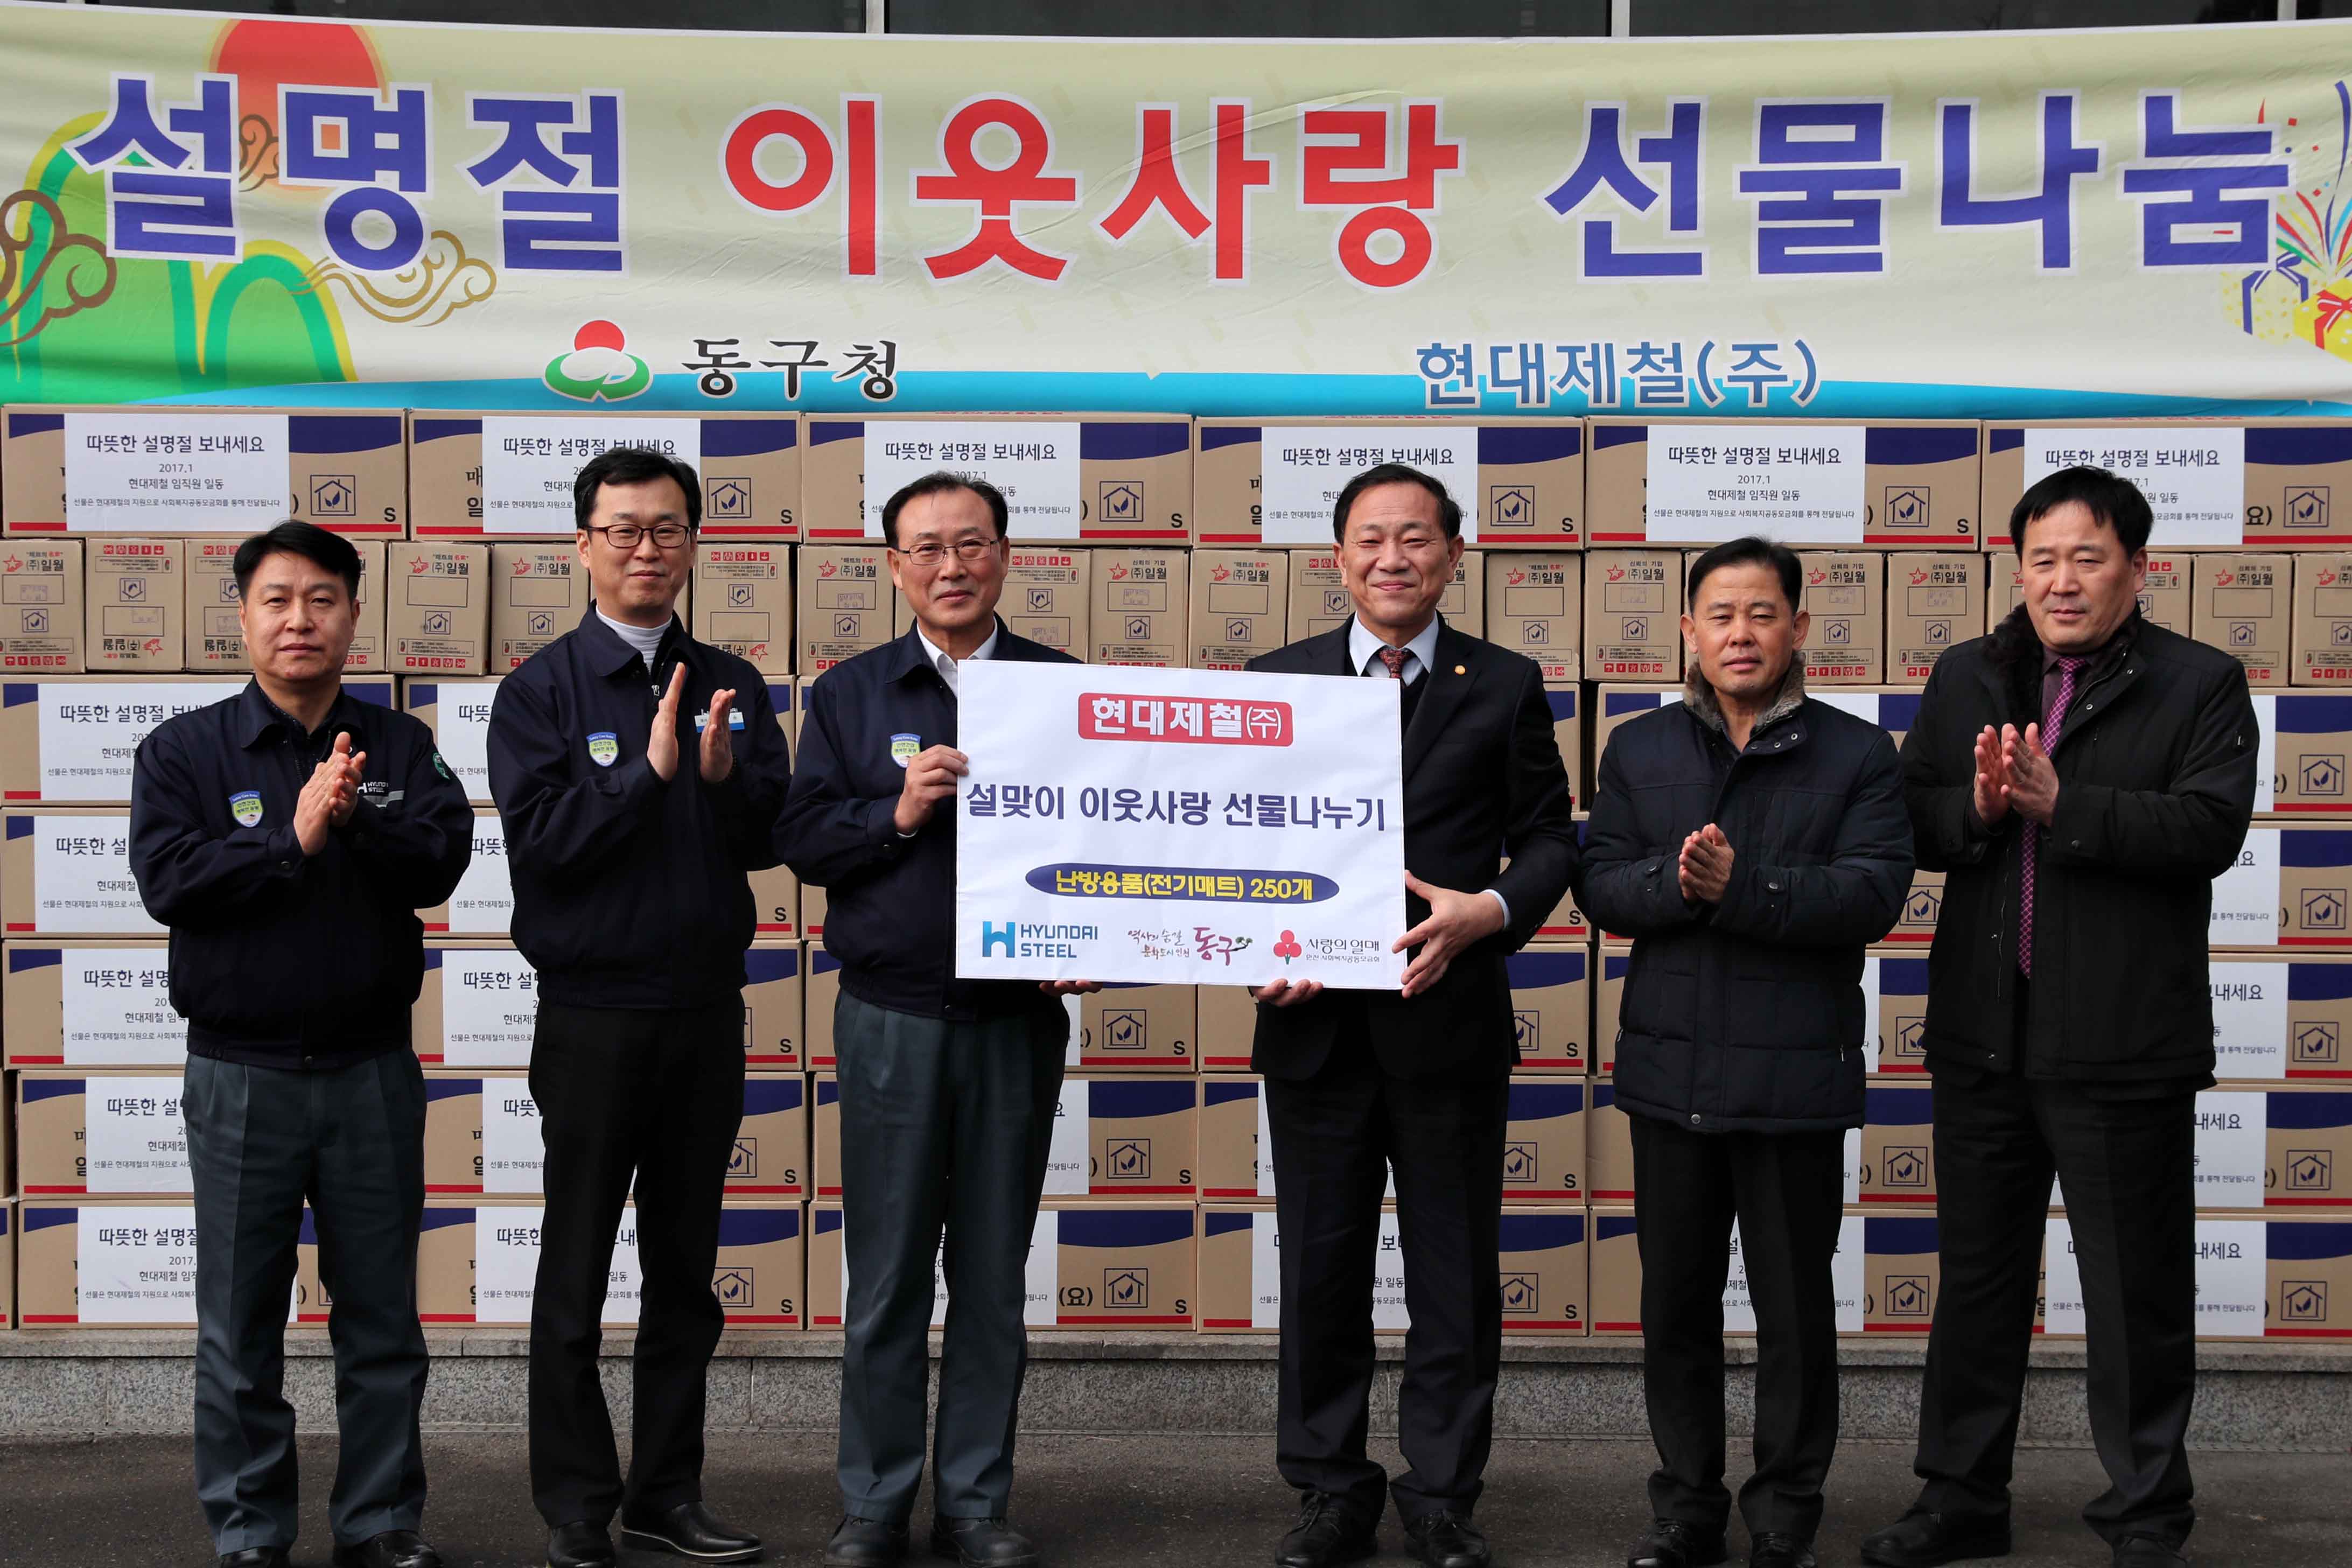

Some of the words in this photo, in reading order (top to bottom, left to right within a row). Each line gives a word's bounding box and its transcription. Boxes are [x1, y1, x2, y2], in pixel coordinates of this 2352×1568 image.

[73, 76, 623, 273] 설명절
[725, 99, 1459, 288] 이웃사랑
[1543, 95, 2290, 277] 선물나눔
[683, 339, 898, 400] 동구청
[1417, 340, 1818, 405] 현대제철(주)
[87, 435, 137, 452] 따뜻한
[143, 436, 191, 453] 설명절
[199, 436, 264, 453] 보내세요
[504, 438, 552, 456] 따뜻한
[558, 438, 606, 456] 설명절
[886, 443, 933, 460] 따뜻한
[939, 443, 985, 461] 설명절
[993, 444, 1056, 460] 보내세요
[1284, 448, 1331, 465] 따뜻한
[1336, 448, 1383, 466] 설명절
[1391, 447, 1454, 466] 보내세요
[1669, 447, 1717, 464] 따뜻한
[1723, 447, 1769, 465] 설명절
[1777, 448, 1841, 465] 보내세요
[2046, 450, 2095, 467] 따뜻한
[2101, 450, 2148, 468] 설명절
[2155, 450, 2220, 467] 보내세요
[159, 464, 192, 473] 2017.1
[129, 478, 168, 489] 현대제철
[172, 479, 201, 489] 임직원
[205, 479, 224, 489] 일동
[1738, 475, 1769, 484] 2017.1
[998, 487, 1016, 498] 일동
[1708, 490, 1745, 500] 현대제철
[1749, 490, 1777, 501] 임직원
[1782, 490, 1800, 501] 일동
[2160, 493, 2179, 503] 일동
[384, 507, 396, 522] S
[781, 509, 792, 524] S
[1171, 514, 1182, 528] S
[1562, 517, 1573, 532] S
[1957, 519, 1969, 533] S
[61, 705, 109, 723] 따뜻한
[116, 705, 164, 724] 설명절
[1092, 698, 1282, 739] 현대제철(주)
[967, 784, 1064, 820] 설맞이
[1080, 787, 1211, 825] 이웃사랑
[1223, 793, 1384, 831] 선물나누기
[57, 838, 106, 855] 따뜻한
[97, 879, 137, 891] 현대제철
[1056, 870, 1243, 900] 난방용품(전기매트)
[1250, 877, 1313, 901] 250개
[775, 907, 786, 921] S
[1570, 909, 1581, 925] S
[1021, 924, 1097, 940] HYUNDAI
[1128, 929, 1159, 944] 역사의
[1021, 943, 1077, 958] STEEL
[1193, 927, 1231, 966] 동구
[1306, 939, 1346, 955] 사랑의
[1350, 940, 1379, 954] 열매
[85, 970, 133, 987] 따뜻한
[464, 972, 512, 989] 따뜻한
[125, 1012, 163, 1023] 현대제철
[780, 1039, 792, 1053] S
[1174, 1041, 1185, 1055] S
[1567, 1042, 1578, 1057] S
[108, 1098, 156, 1116] 따뜻한
[148, 1140, 187, 1151] 현대제철
[100, 1228, 148, 1245] 따뜻한
[139, 1271, 177, 1282] 현대제철
[1059, 1287, 1093, 1306] (요)
